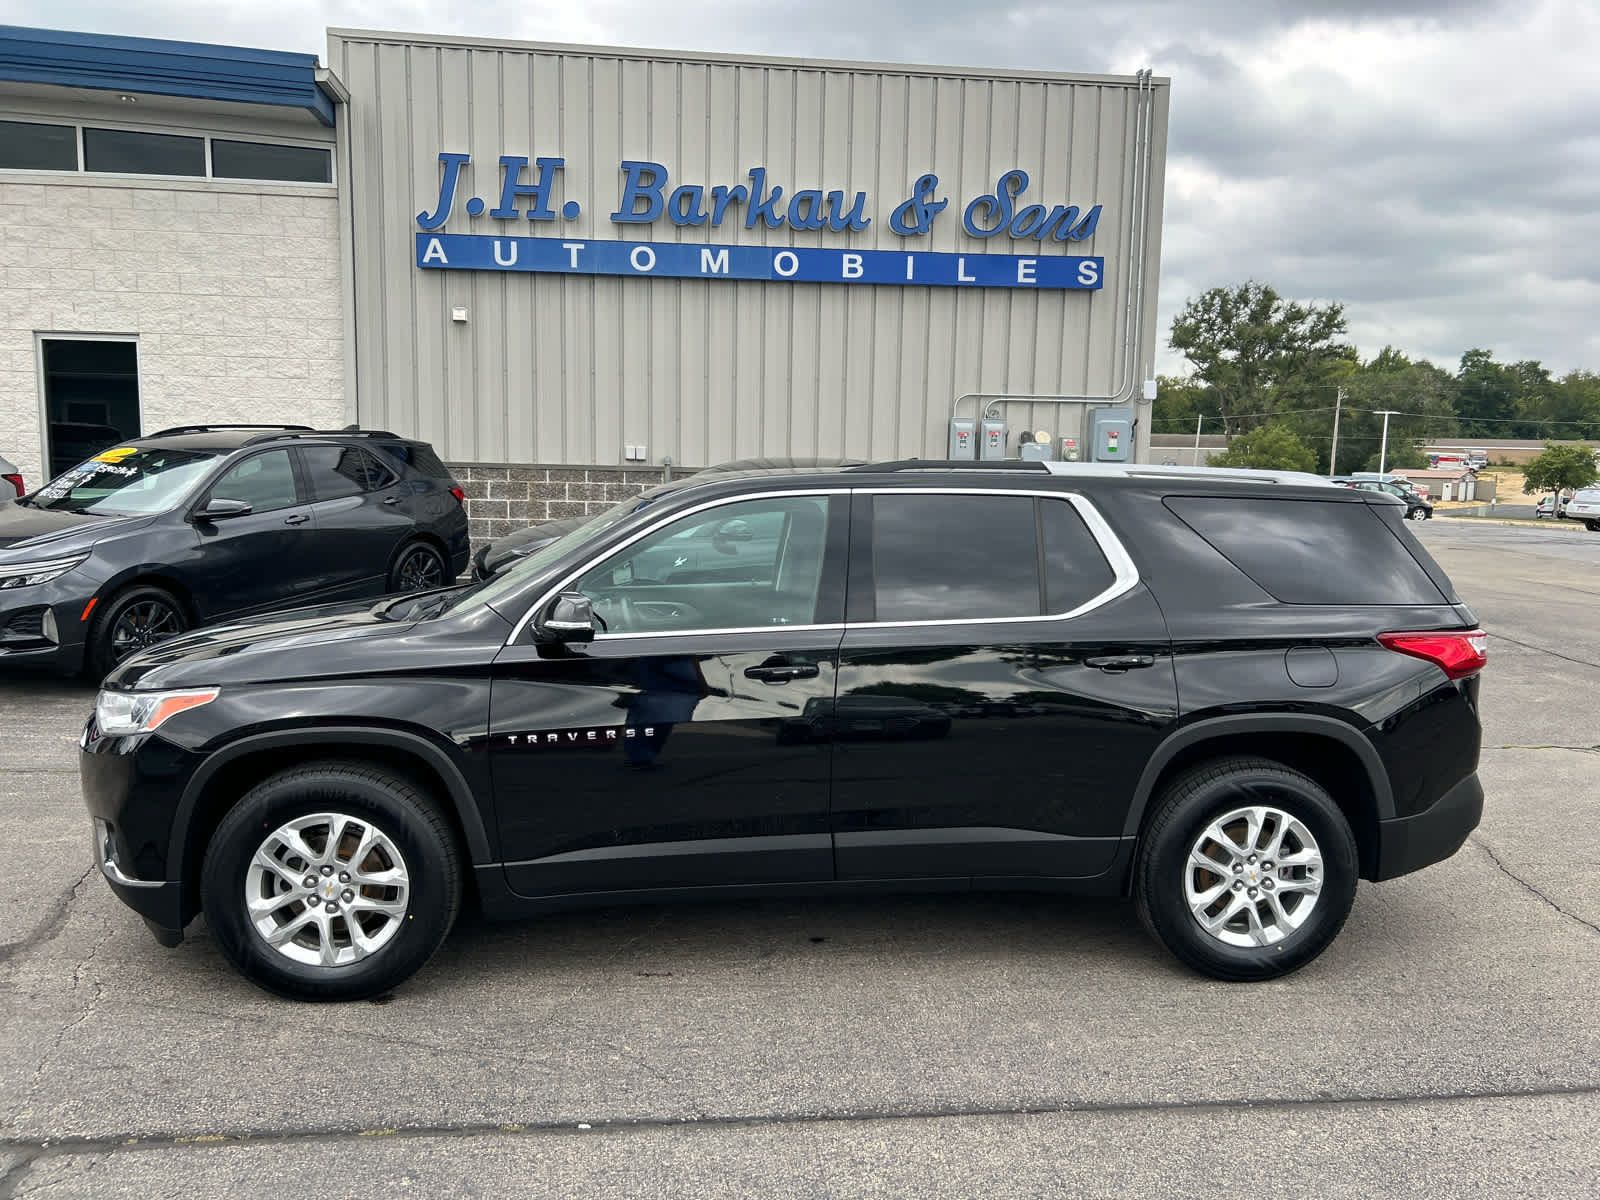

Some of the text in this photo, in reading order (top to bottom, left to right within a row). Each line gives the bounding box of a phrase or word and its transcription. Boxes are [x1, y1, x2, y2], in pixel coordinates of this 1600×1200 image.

[610, 160, 871, 233] Barkau
[888, 173, 949, 236] &
[962, 169, 1103, 242] Sons
[422, 238, 1098, 285] AUTOMOBILES
[507, 727, 655, 745] TRAVERSE
